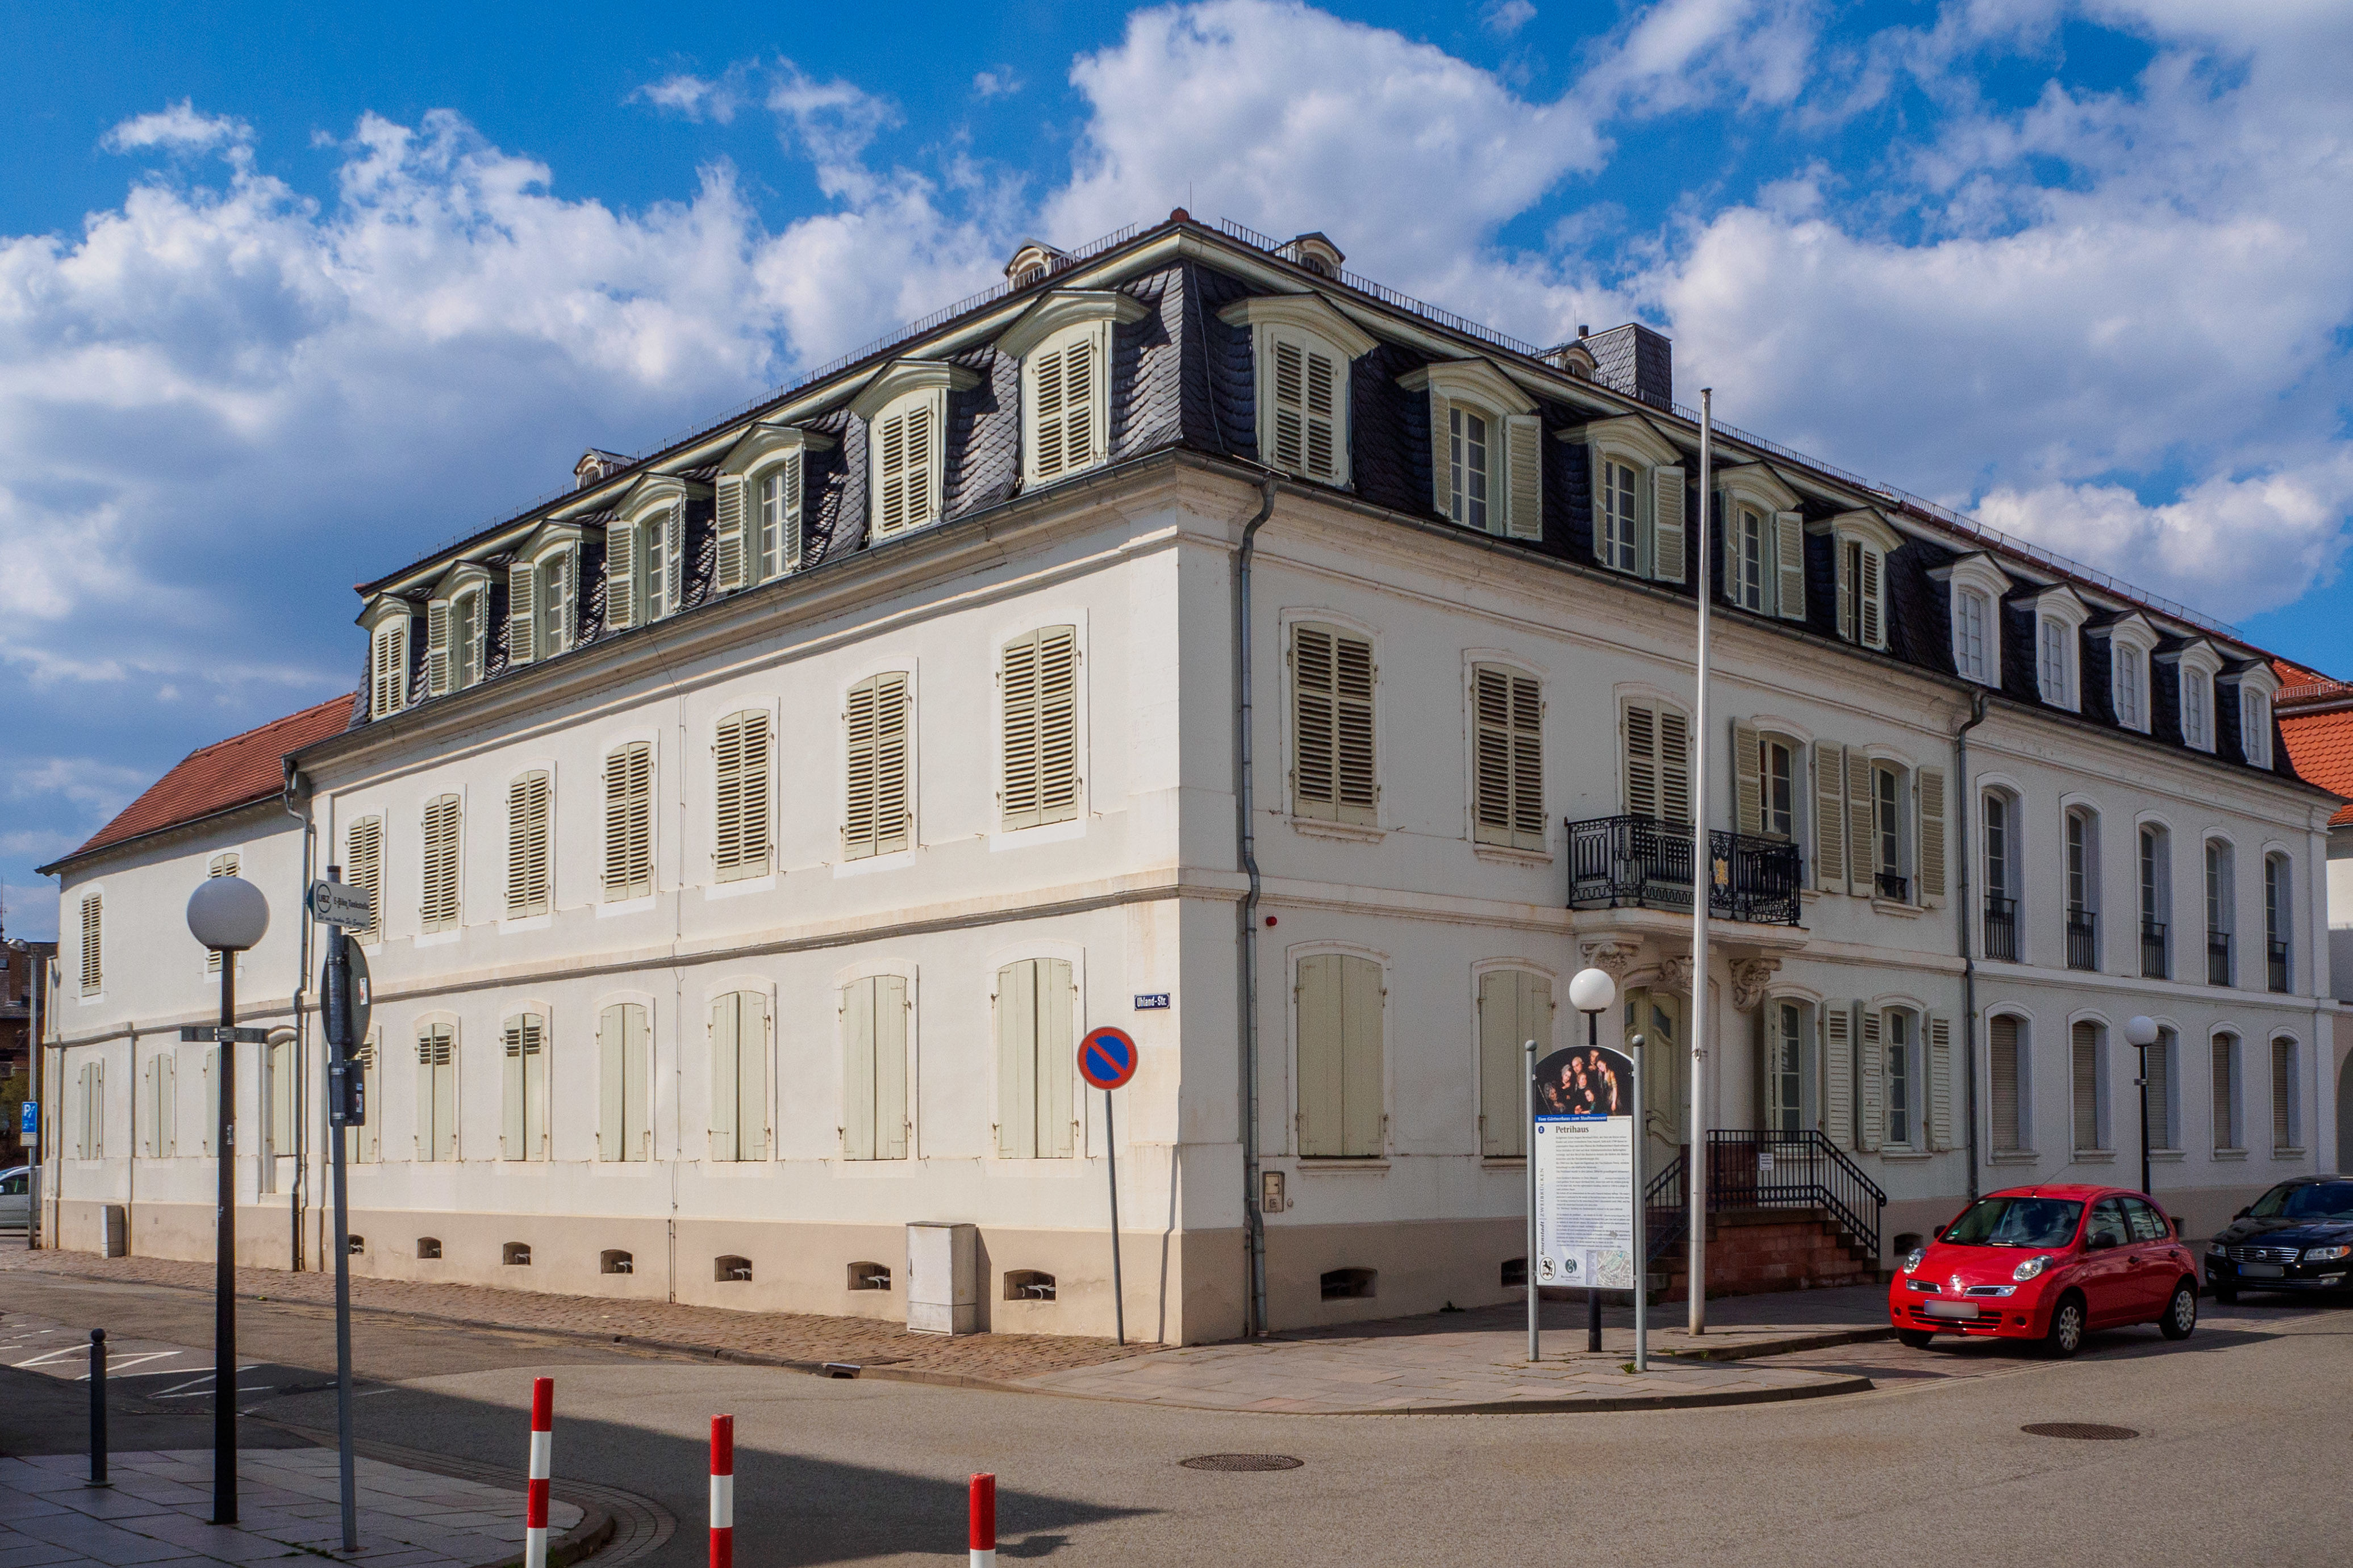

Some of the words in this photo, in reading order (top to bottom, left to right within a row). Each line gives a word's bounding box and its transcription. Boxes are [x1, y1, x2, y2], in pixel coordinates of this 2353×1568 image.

[318, 894, 330, 904] UBZ
[1137, 996, 1167, 1007] Uhland-Str.
[23, 1104, 31, 1117] P
